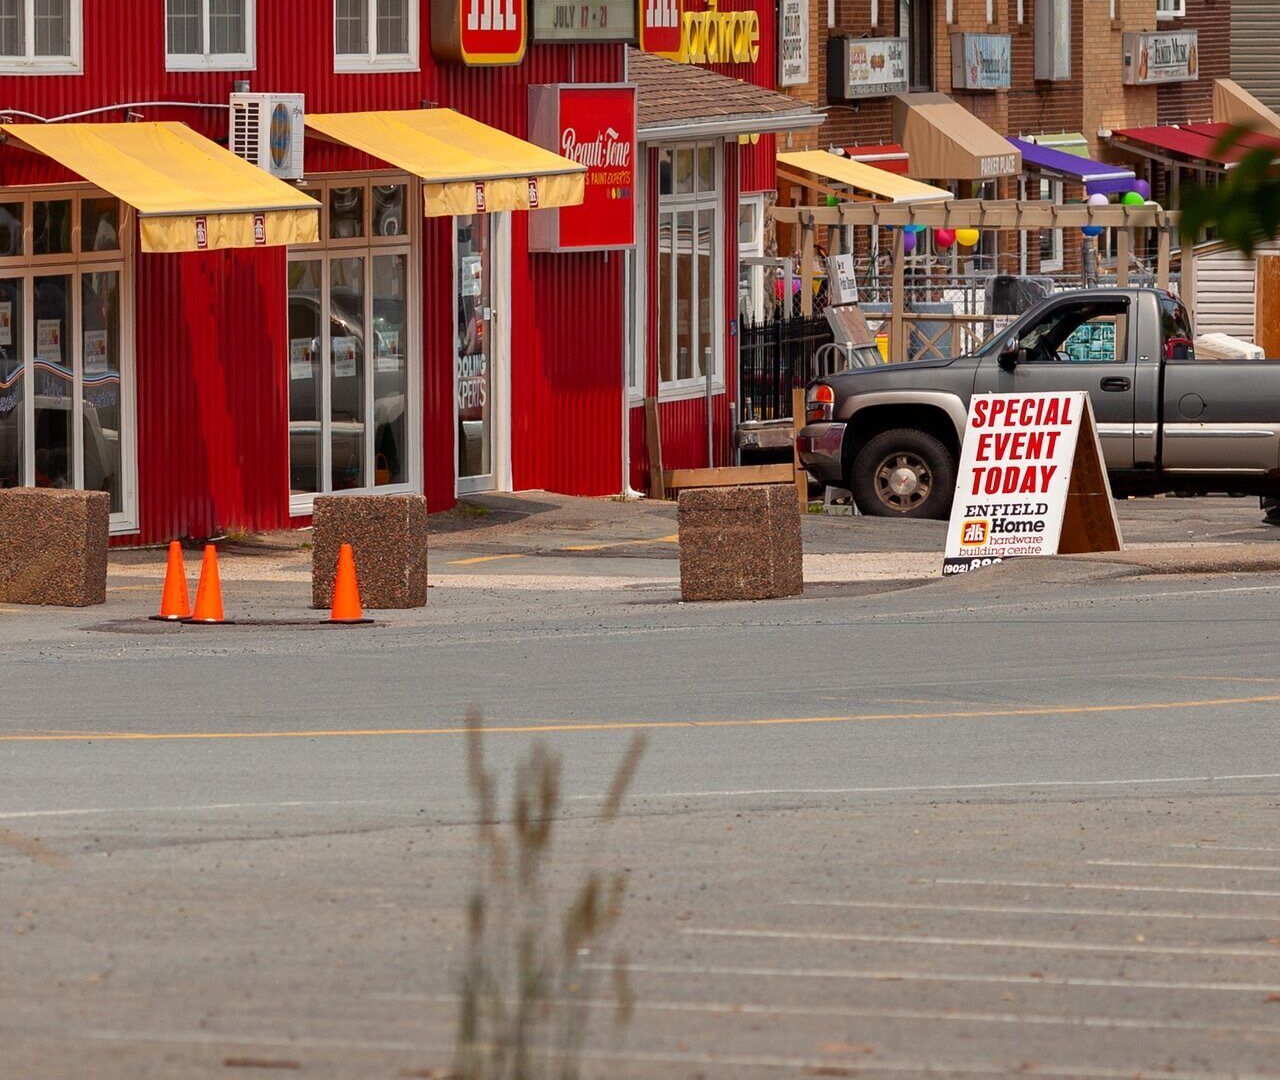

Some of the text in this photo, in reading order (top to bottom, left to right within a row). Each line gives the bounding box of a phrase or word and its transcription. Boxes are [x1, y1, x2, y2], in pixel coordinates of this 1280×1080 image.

[553, 6, 575, 28] JULY
[580, 6, 589, 28] 17
[600, 6, 607, 28] 21
[971, 397, 1073, 428] SPECIAL
[975, 431, 1061, 462] EVENT
[971, 465, 1058, 495] TODAY
[964, 502, 1048, 518] ENFIELD
[990, 517, 1045, 534] Home
[989, 535, 1043, 545] hardware
[958, 546, 1042, 557] building centre
[944, 564, 968, 574] (902)
